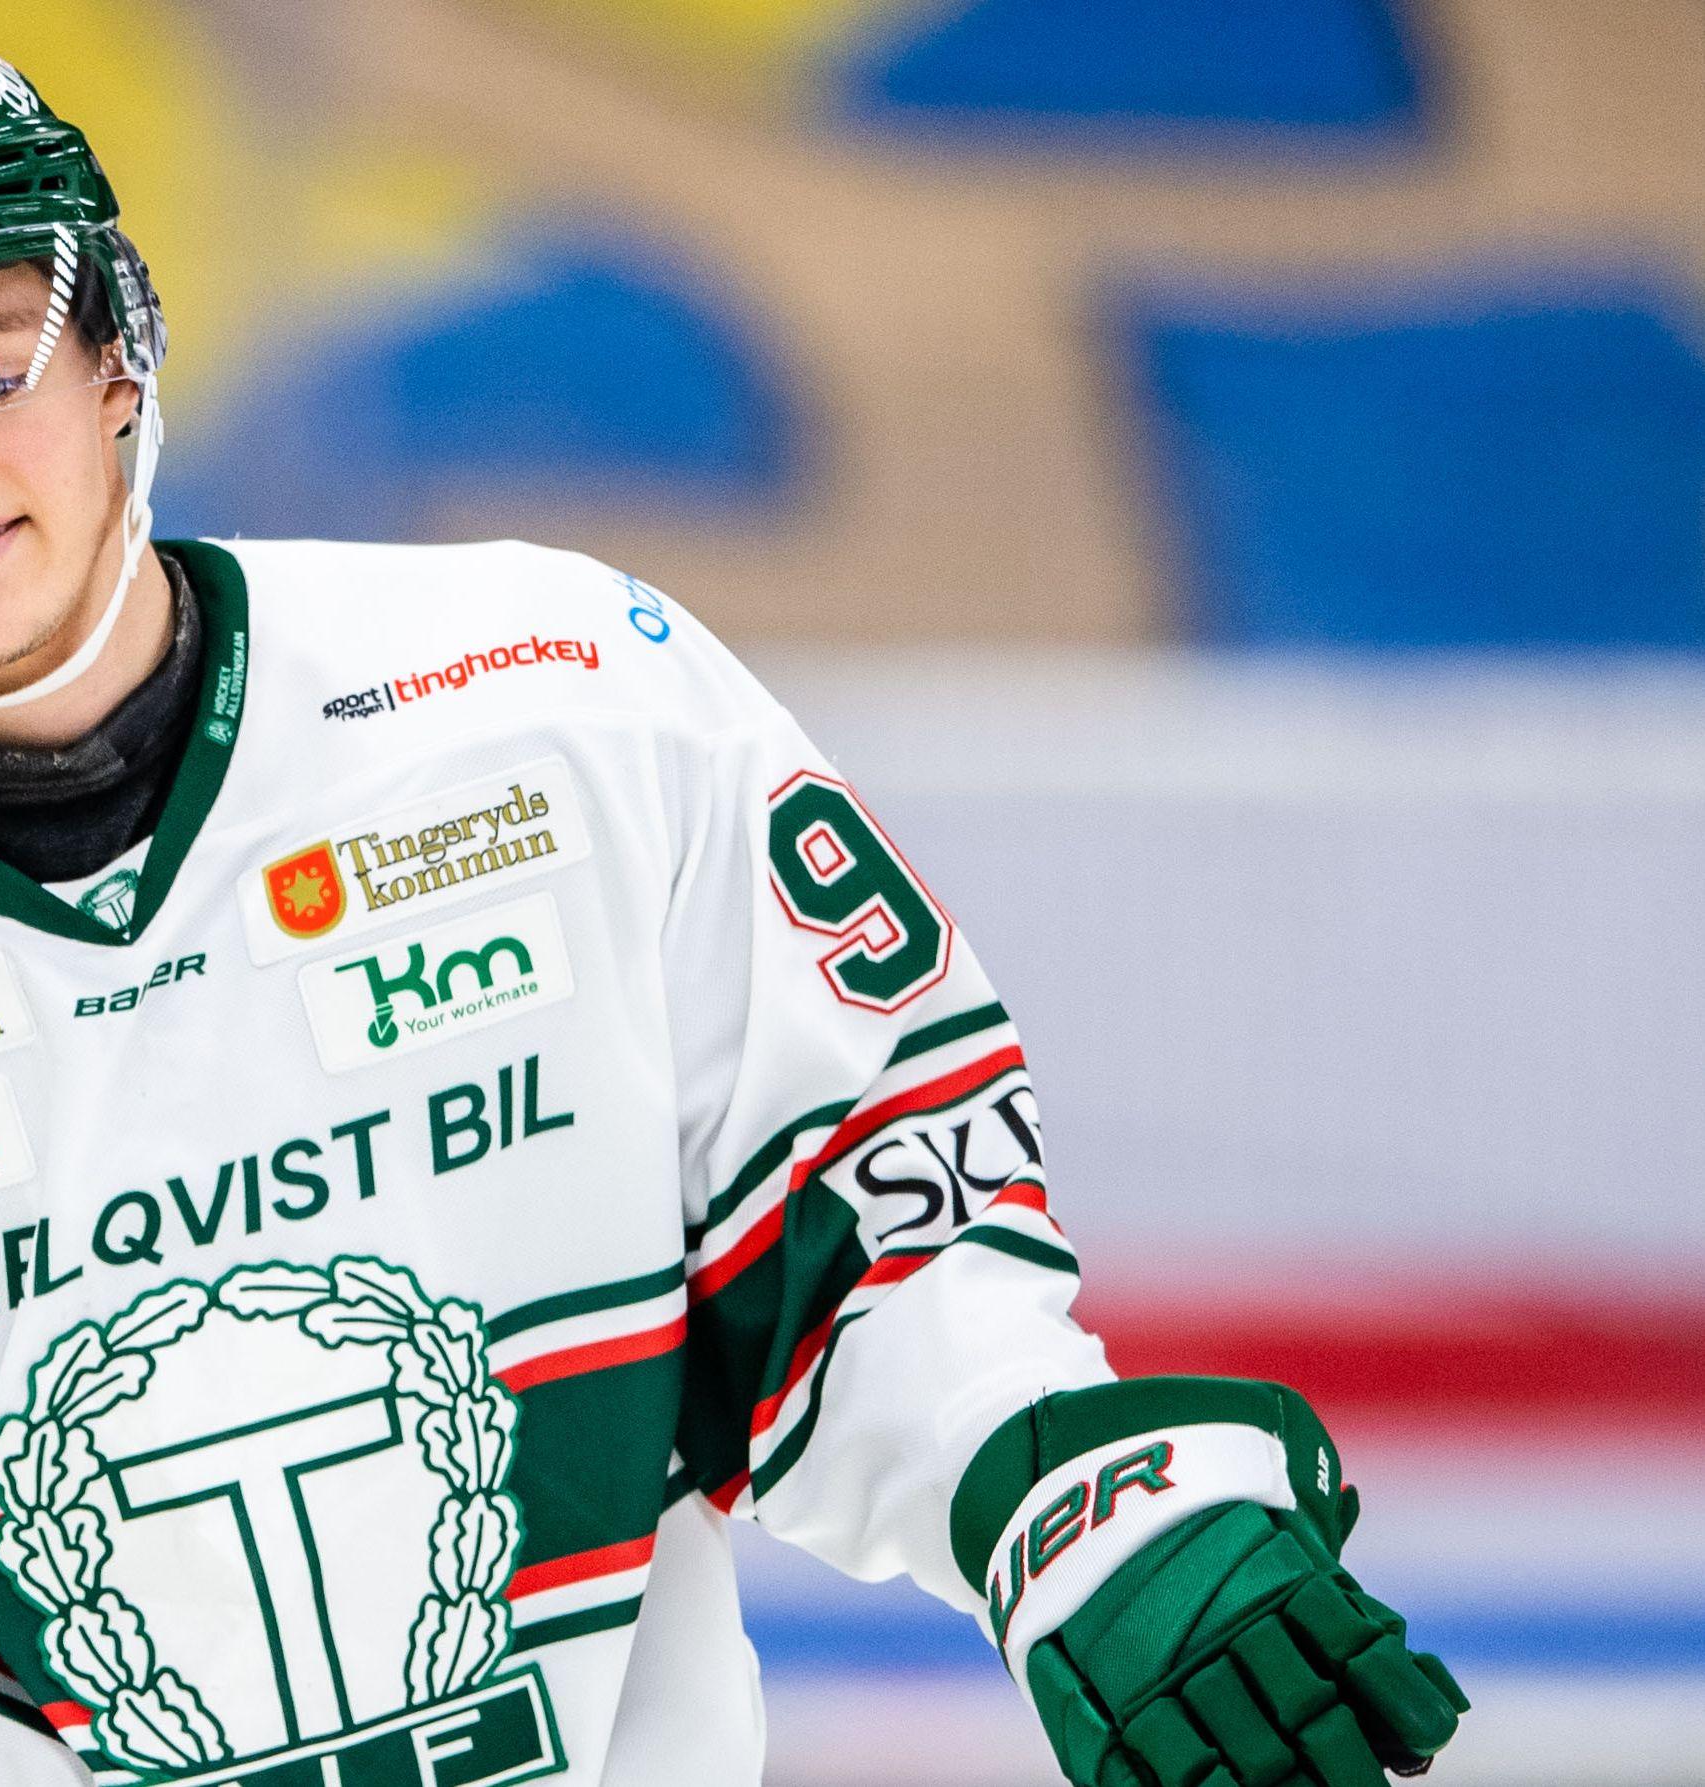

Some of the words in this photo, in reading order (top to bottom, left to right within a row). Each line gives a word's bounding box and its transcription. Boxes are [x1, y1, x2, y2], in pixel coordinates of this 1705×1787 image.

[322, 687, 382, 719] sport
[336, 784, 550, 877] Tingsryds
[354, 828, 559, 912] kommun
[768, 769, 955, 1015] 9
[74, 951, 206, 1018] BAER
[404, 1012, 446, 1035] Your
[451, 981, 539, 1021] workmate
[427, 1053, 575, 1176] BIL
